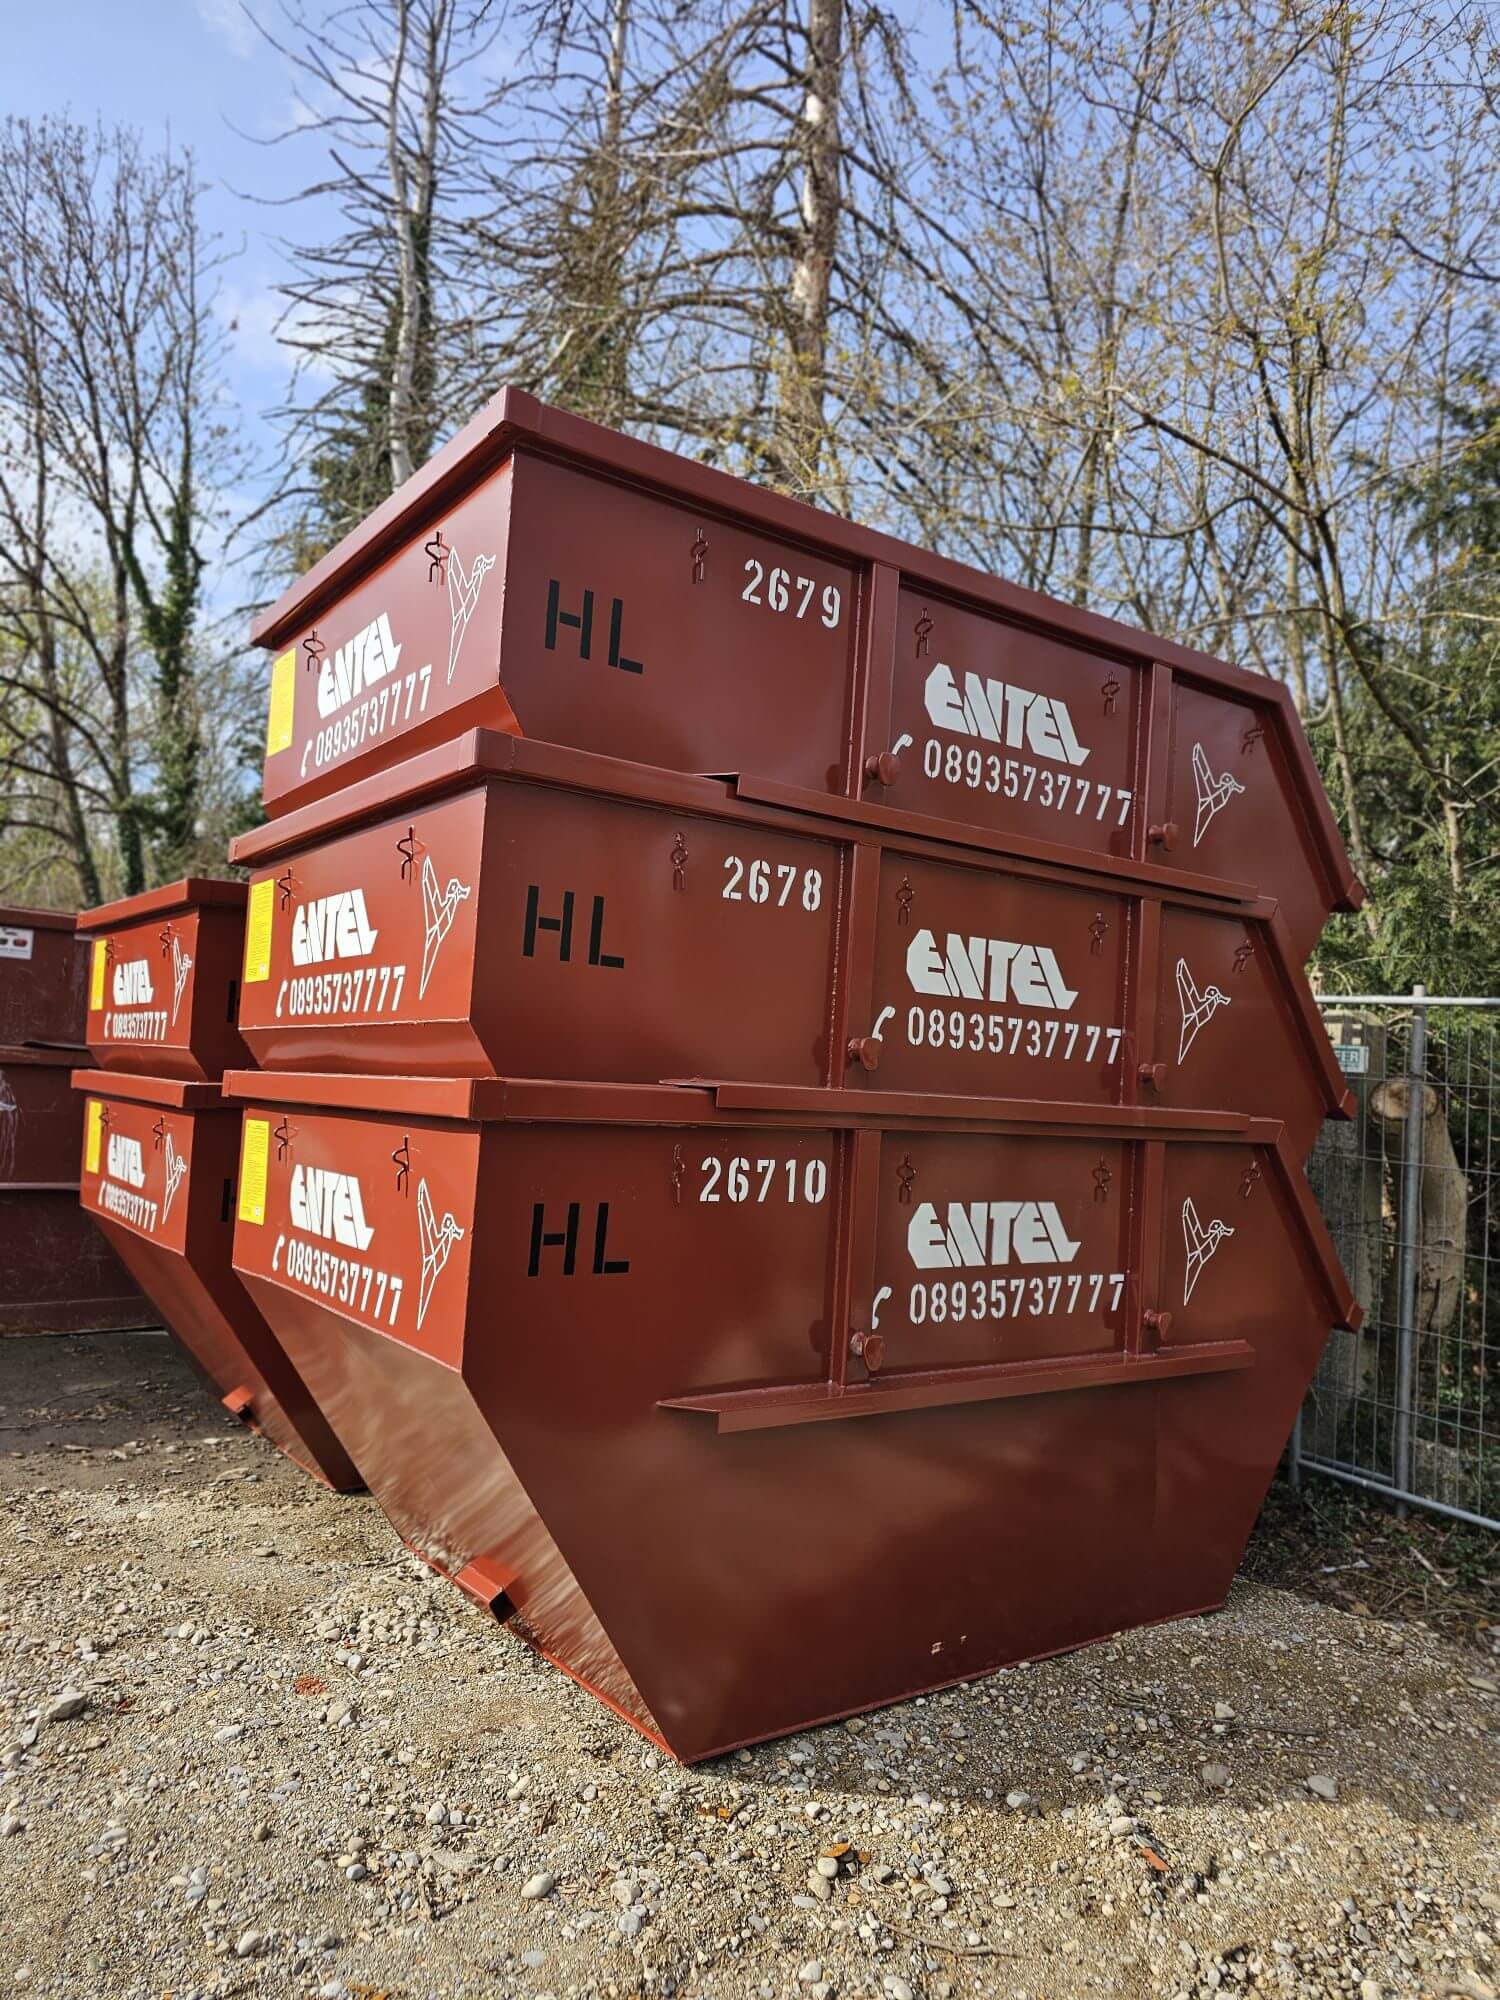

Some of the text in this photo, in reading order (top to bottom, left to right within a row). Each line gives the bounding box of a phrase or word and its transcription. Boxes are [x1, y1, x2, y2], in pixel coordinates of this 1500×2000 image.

[545, 579, 643, 675] HL
[742, 559, 841, 629] 2679
[317, 612, 402, 719] ENTEL
[315, 663, 433, 767] 08935737777
[924, 662, 1091, 766] ENTEL
[924, 739, 1132, 826] 08935737777
[722, 855, 822, 912] 2678
[292, 888, 378, 966] ENTEL
[523, 885, 624, 968] HL
[113, 959, 154, 1005] ENTEL
[289, 965, 406, 1016] 08935737777
[906, 929, 1079, 1010] ENTEL
[907, 1006, 1122, 1064] 08935737777
[290, 1163, 375, 1251] ENTEL
[699, 1157, 827, 1204] 26710
[528, 1202, 630, 1277] HL
[907, 1201, 1082, 1269] ENTEL
[287, 1239, 402, 1326] 08935737777
[909, 1273, 1125, 1325] 08935737777
